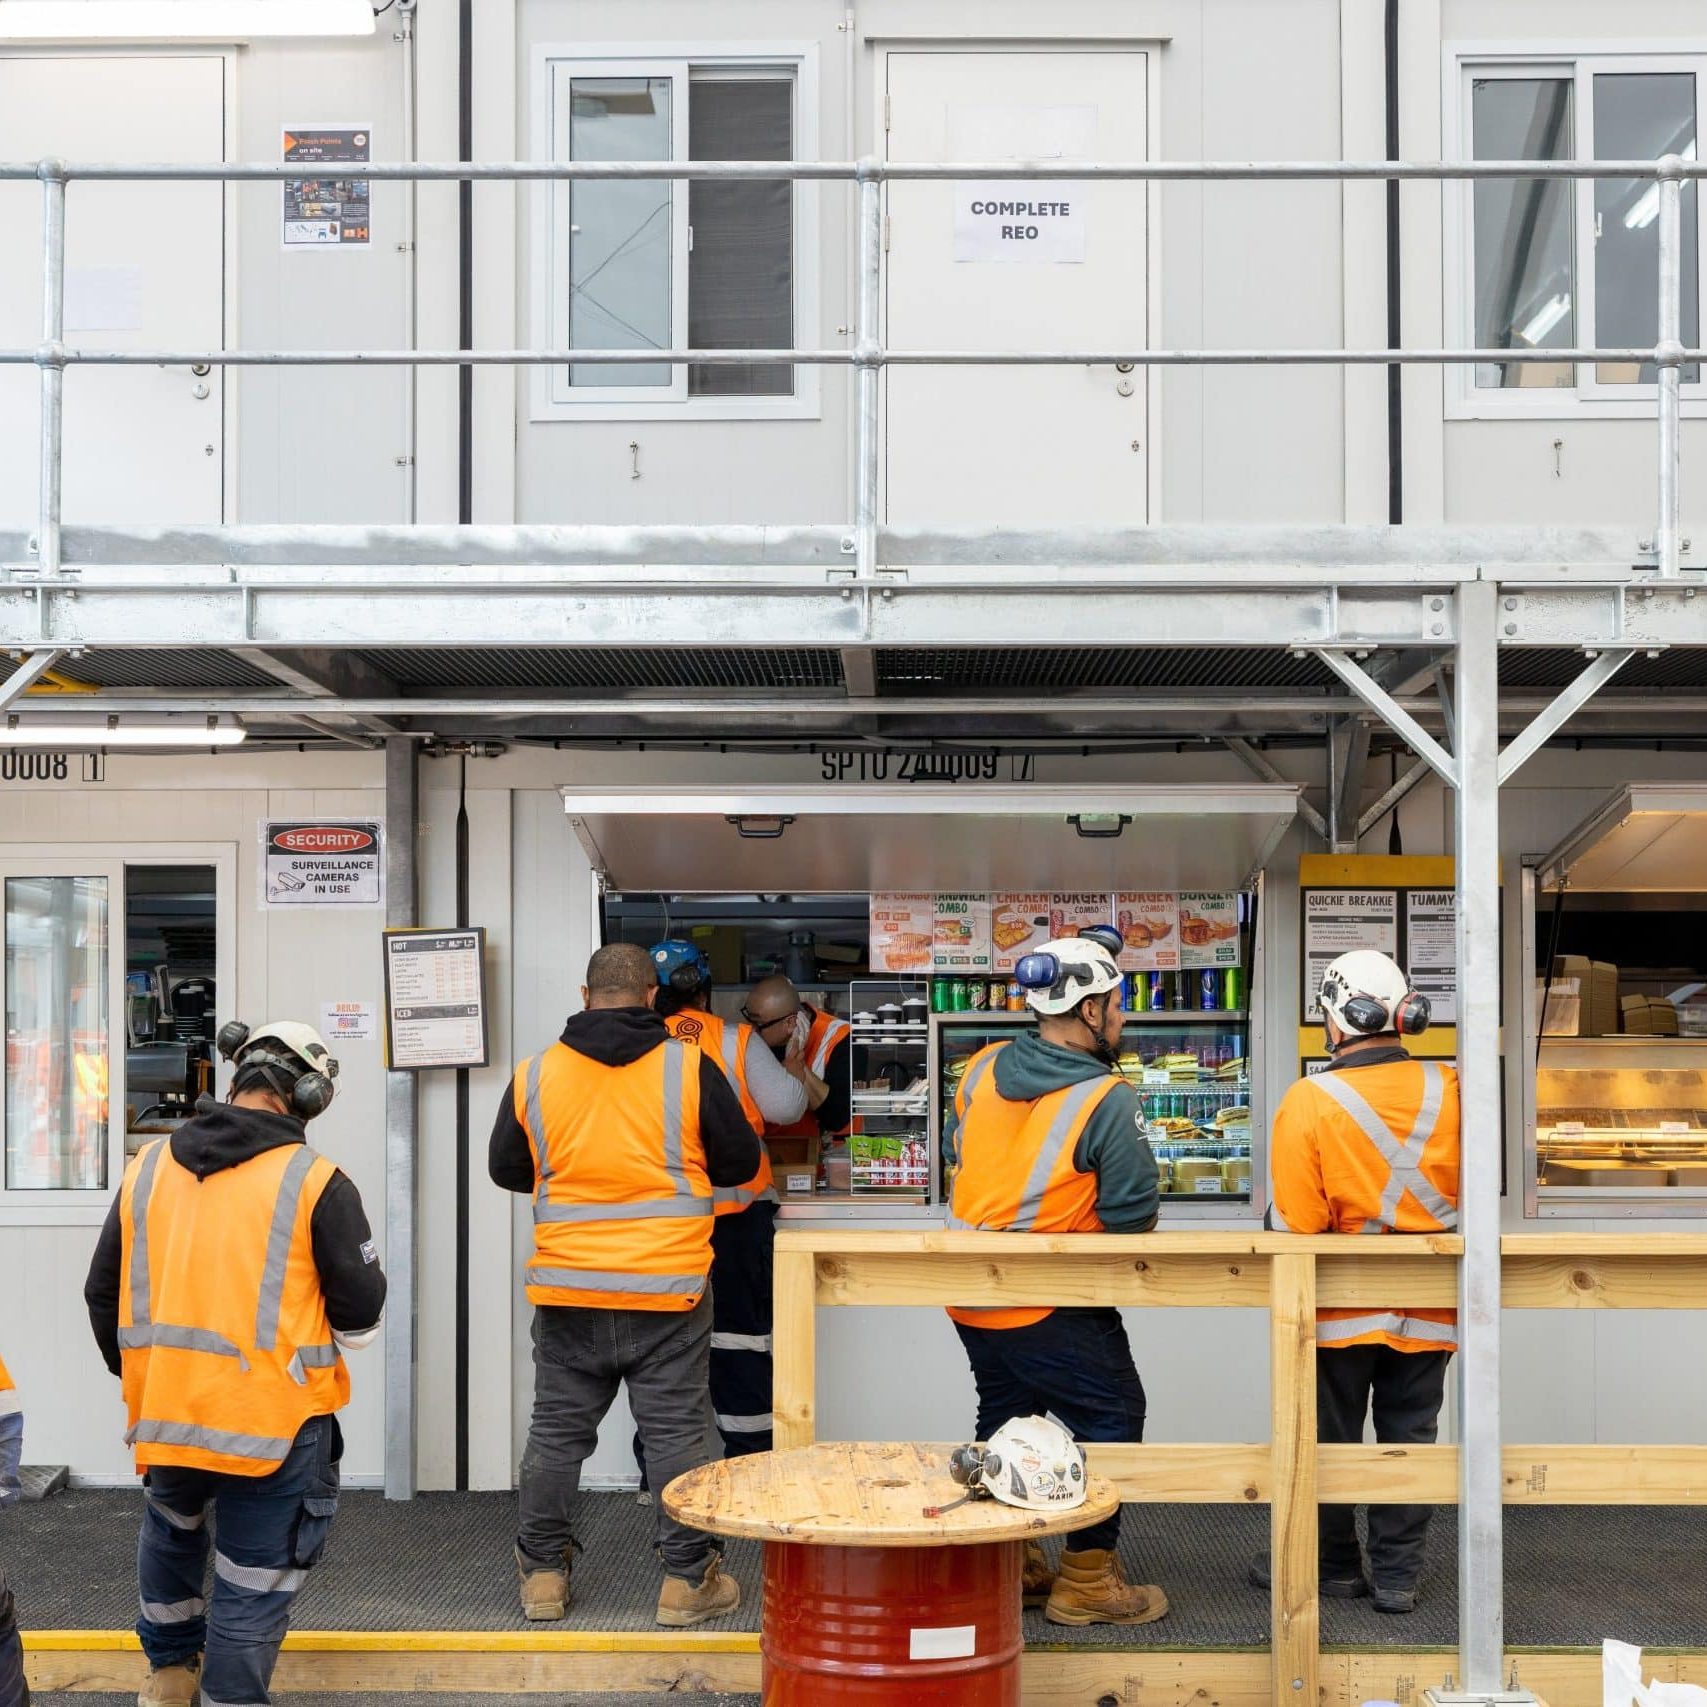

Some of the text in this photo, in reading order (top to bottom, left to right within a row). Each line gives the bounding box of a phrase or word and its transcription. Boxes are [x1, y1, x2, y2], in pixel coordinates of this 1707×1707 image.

[310, 146, 322, 154] site
[971, 201, 1070, 217] COMPLETE
[1001, 226, 1039, 240] REO
[2, 753, 68, 780] 0008
[286, 834, 361, 846] SECURITY
[291, 861, 374, 870] SURVEILLANCE
[305, 873, 360, 882] CAMERAS
[315, 885, 351, 894] IN USE
[996, 893, 1048, 903] CHICKEN
[1053, 893, 1107, 904] BURGER
[1119, 893, 1173, 903] BURGER
[1179, 892, 1234, 901] BURGER
[1309, 895, 1393, 906] QUICKIE BREAKKIE
[1411, 894, 1455, 906] TUMMY
[1017, 903, 1048, 913] COMBO
[1074, 905, 1099, 914] COMBO
[1140, 904, 1165, 912] COMBO
[1200, 902, 1225, 911] COMBO
[392, 942, 408, 951] HOT
